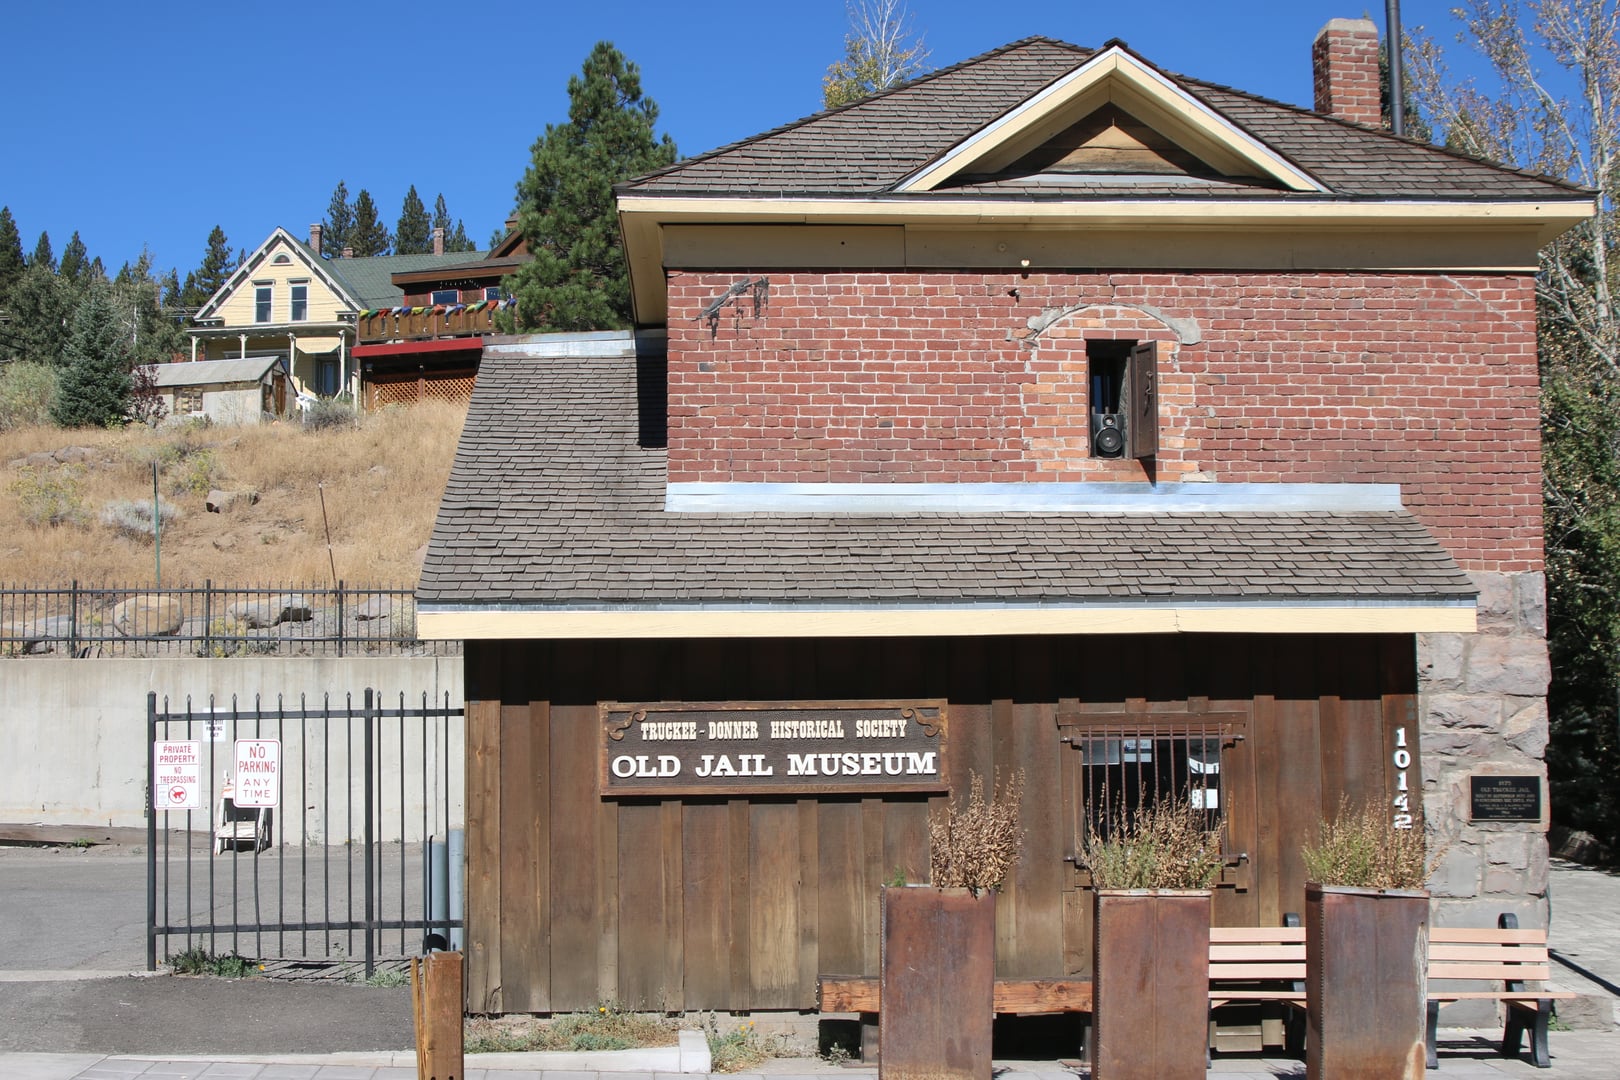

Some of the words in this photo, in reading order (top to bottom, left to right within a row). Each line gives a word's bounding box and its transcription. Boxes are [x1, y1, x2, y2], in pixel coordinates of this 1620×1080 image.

[770, 720, 845, 740] HISTORICAL
[856, 719, 907, 738] SOCIETY
[163, 745, 192, 754] PRIVATE
[249, 746, 266, 759] NO
[160, 755, 196, 763] PROPERTY
[239, 761, 276, 773] PARKING
[612, 755, 681, 778] OLD
[695, 754, 773, 777] JAIL
[787, 752, 937, 776] MUSEUM
[174, 766, 182, 774] NO
[160, 776, 196, 784] TRESPASSING
[244, 778, 271, 786] ANY
[1394, 727, 1412, 829] 10142
[243, 789, 271, 798] TIME
